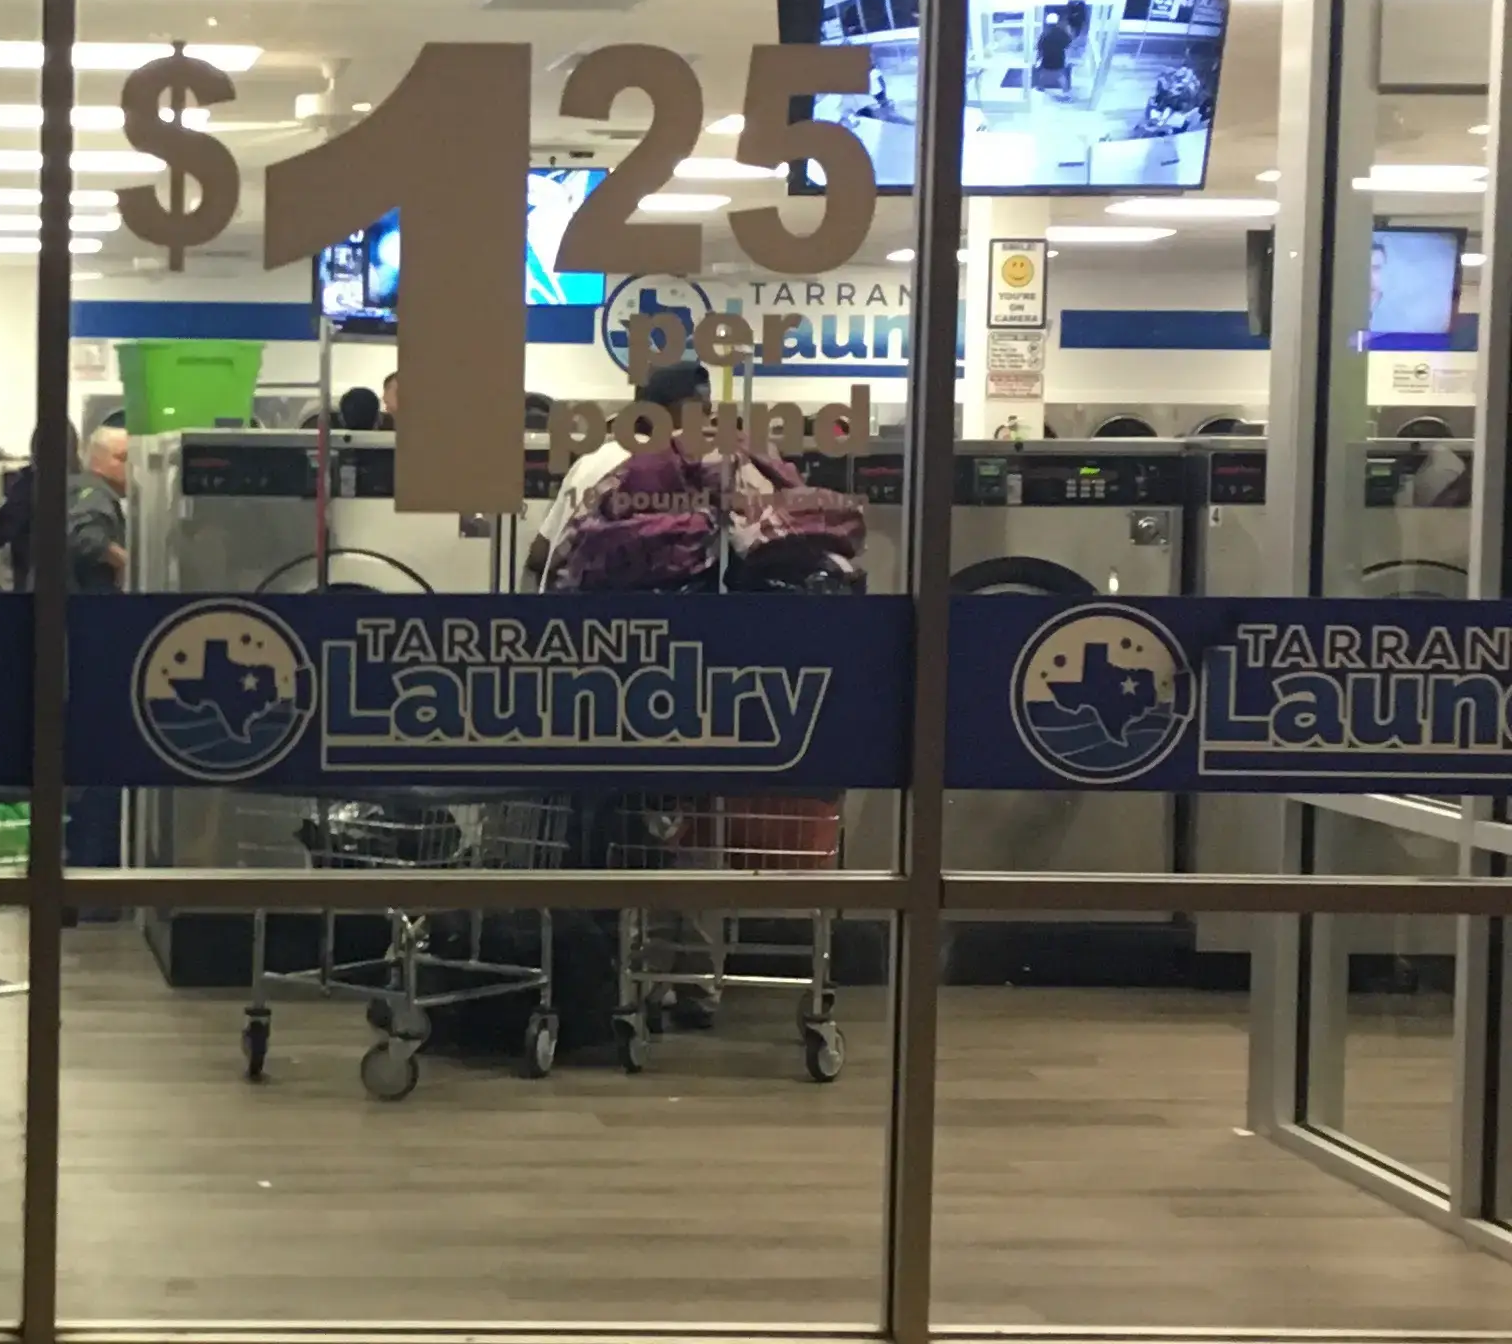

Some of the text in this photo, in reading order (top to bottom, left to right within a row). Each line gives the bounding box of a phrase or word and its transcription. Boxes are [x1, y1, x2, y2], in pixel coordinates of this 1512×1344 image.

[748, 282, 913, 307] TARRAN
[994, 314, 1038, 323] CAMERA
[1008, 303, 1025, 312] ON
[628, 311, 803, 385] per
[549, 384, 870, 468] pound
[612, 487, 712, 515] pound
[355, 616, 671, 665] TARRANT
[1237, 623, 1512, 672] TARRAN
[320, 640, 832, 772] Laundry
[1198, 645, 1512, 775] Laun
